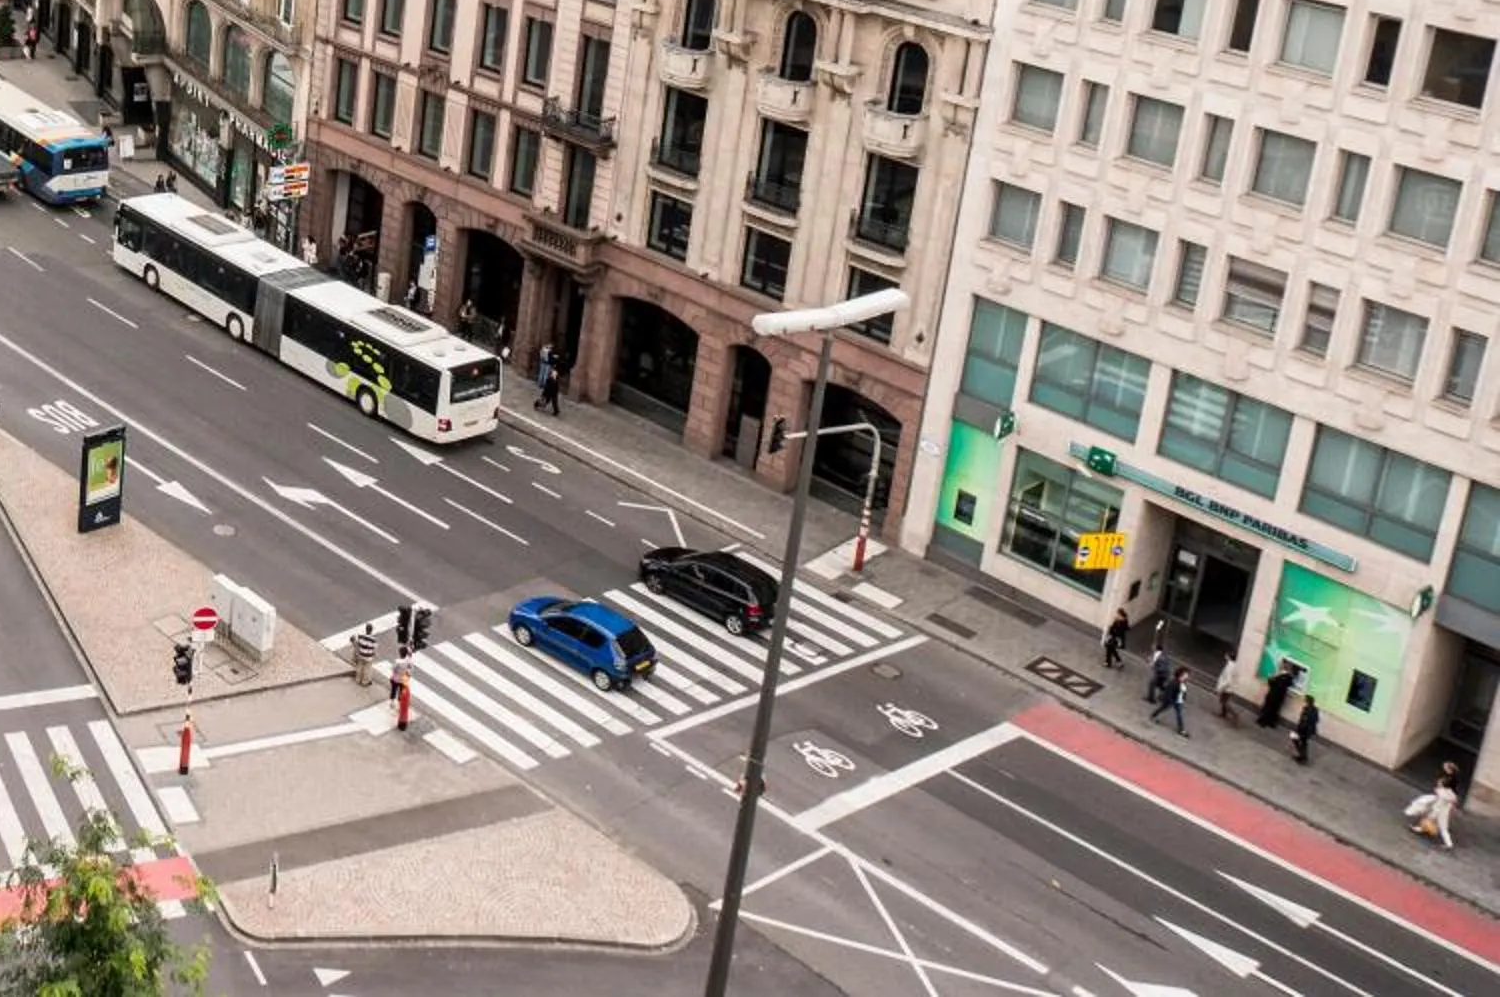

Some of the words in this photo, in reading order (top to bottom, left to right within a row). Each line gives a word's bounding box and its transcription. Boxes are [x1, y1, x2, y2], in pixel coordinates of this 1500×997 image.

[26, 399, 100, 434] BUS
[1174, 486, 1203, 506] BGL
[1209, 499, 1240, 520] BNP
[1243, 514, 1308, 549] PARIBAS
